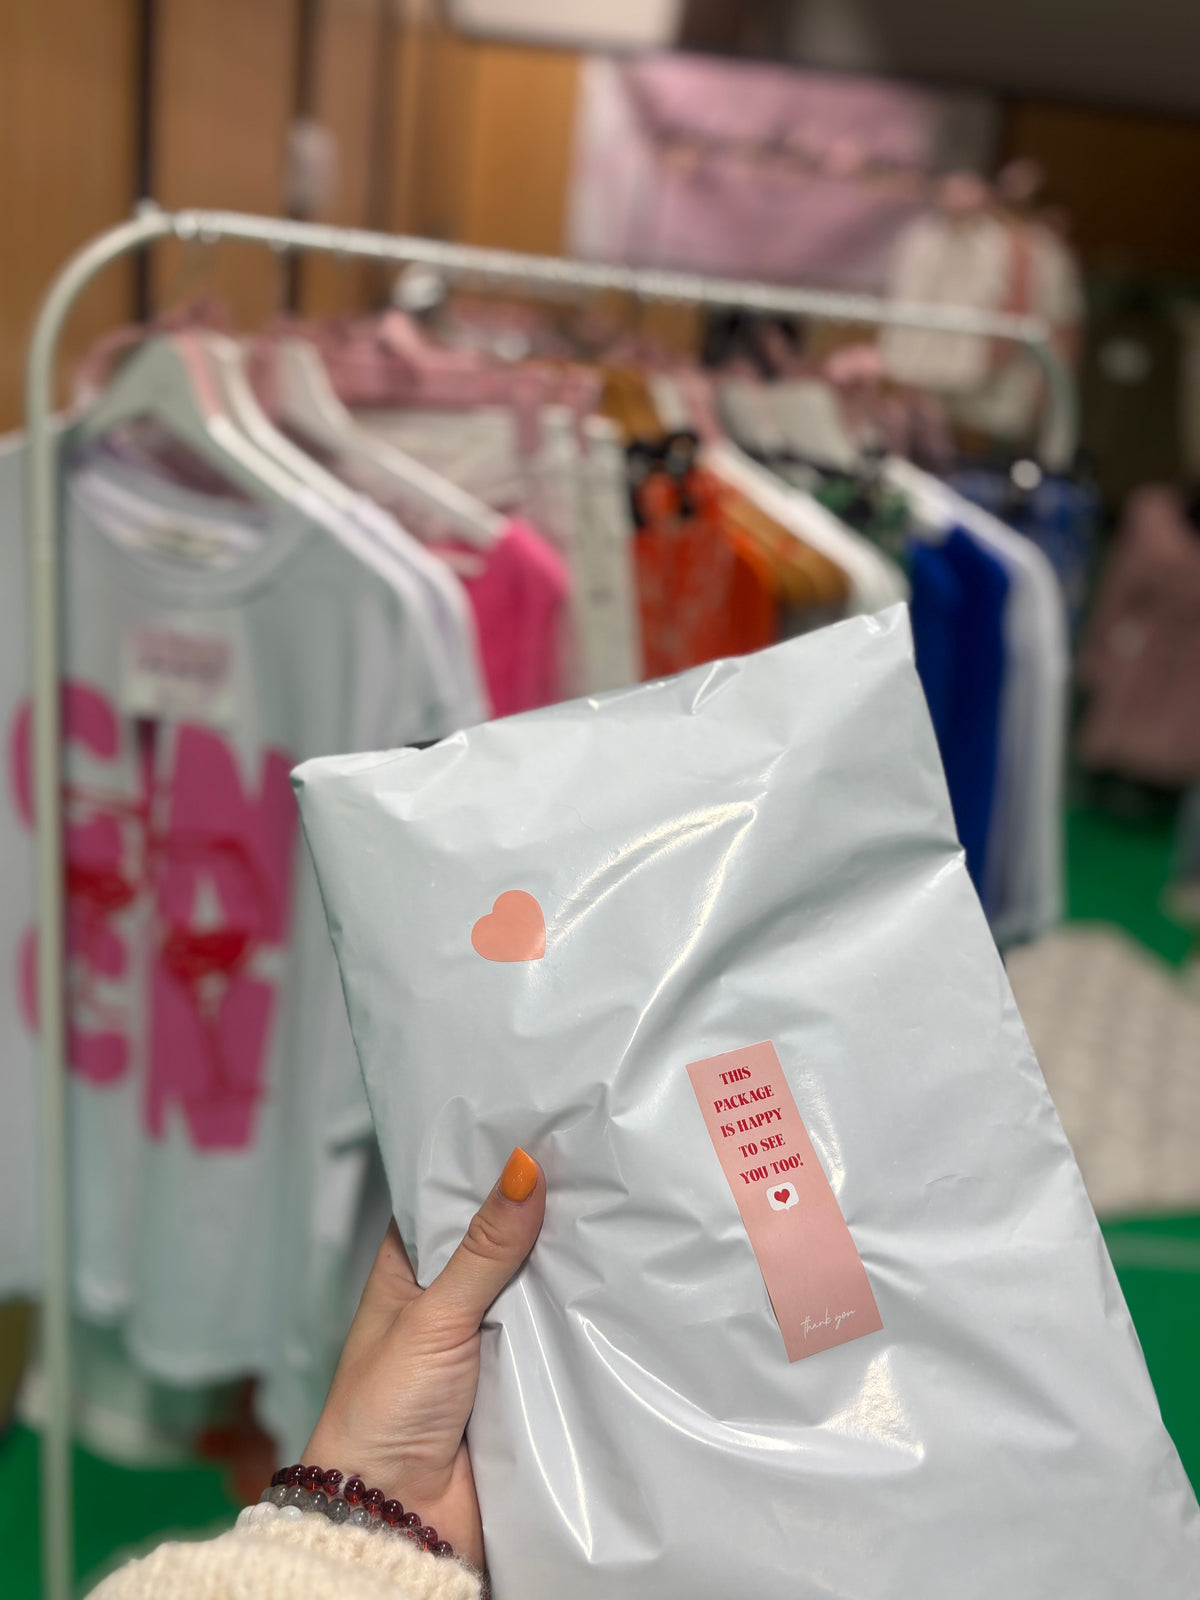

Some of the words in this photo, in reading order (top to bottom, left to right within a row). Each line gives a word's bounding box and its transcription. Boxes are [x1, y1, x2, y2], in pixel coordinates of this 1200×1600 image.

[719, 1066, 751, 1085] THIS
[714, 1085, 774, 1113] PACKAGE
[720, 1122, 735, 1138] IS
[737, 1108, 782, 1132] HAPPY
[738, 1143, 758, 1158] TO
[760, 1133, 785, 1152] SEE
[739, 1165, 768, 1185] YOU
[770, 1152, 804, 1175] TOO!
[800, 1306, 832, 1339] thank
[835, 1310, 855, 1330] you
